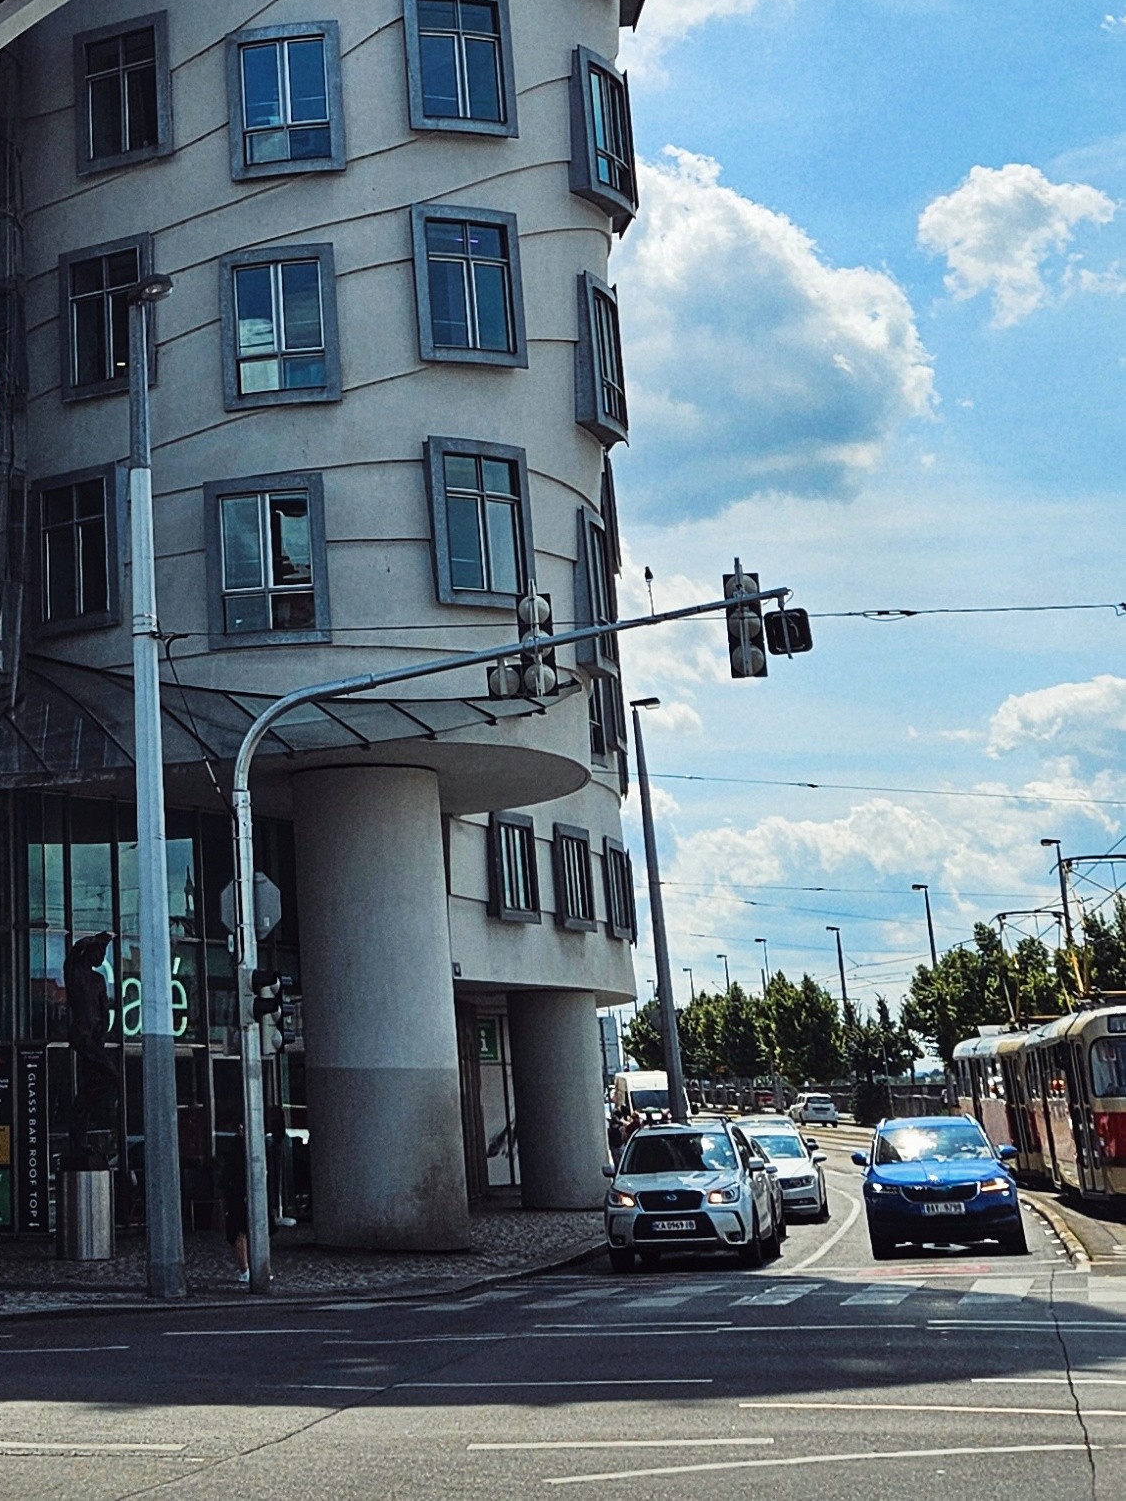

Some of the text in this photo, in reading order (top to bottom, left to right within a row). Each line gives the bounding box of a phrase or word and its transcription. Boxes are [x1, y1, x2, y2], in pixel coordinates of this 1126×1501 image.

[27, 1072, 38, 1218] GLASS BAR ROOF TOP
